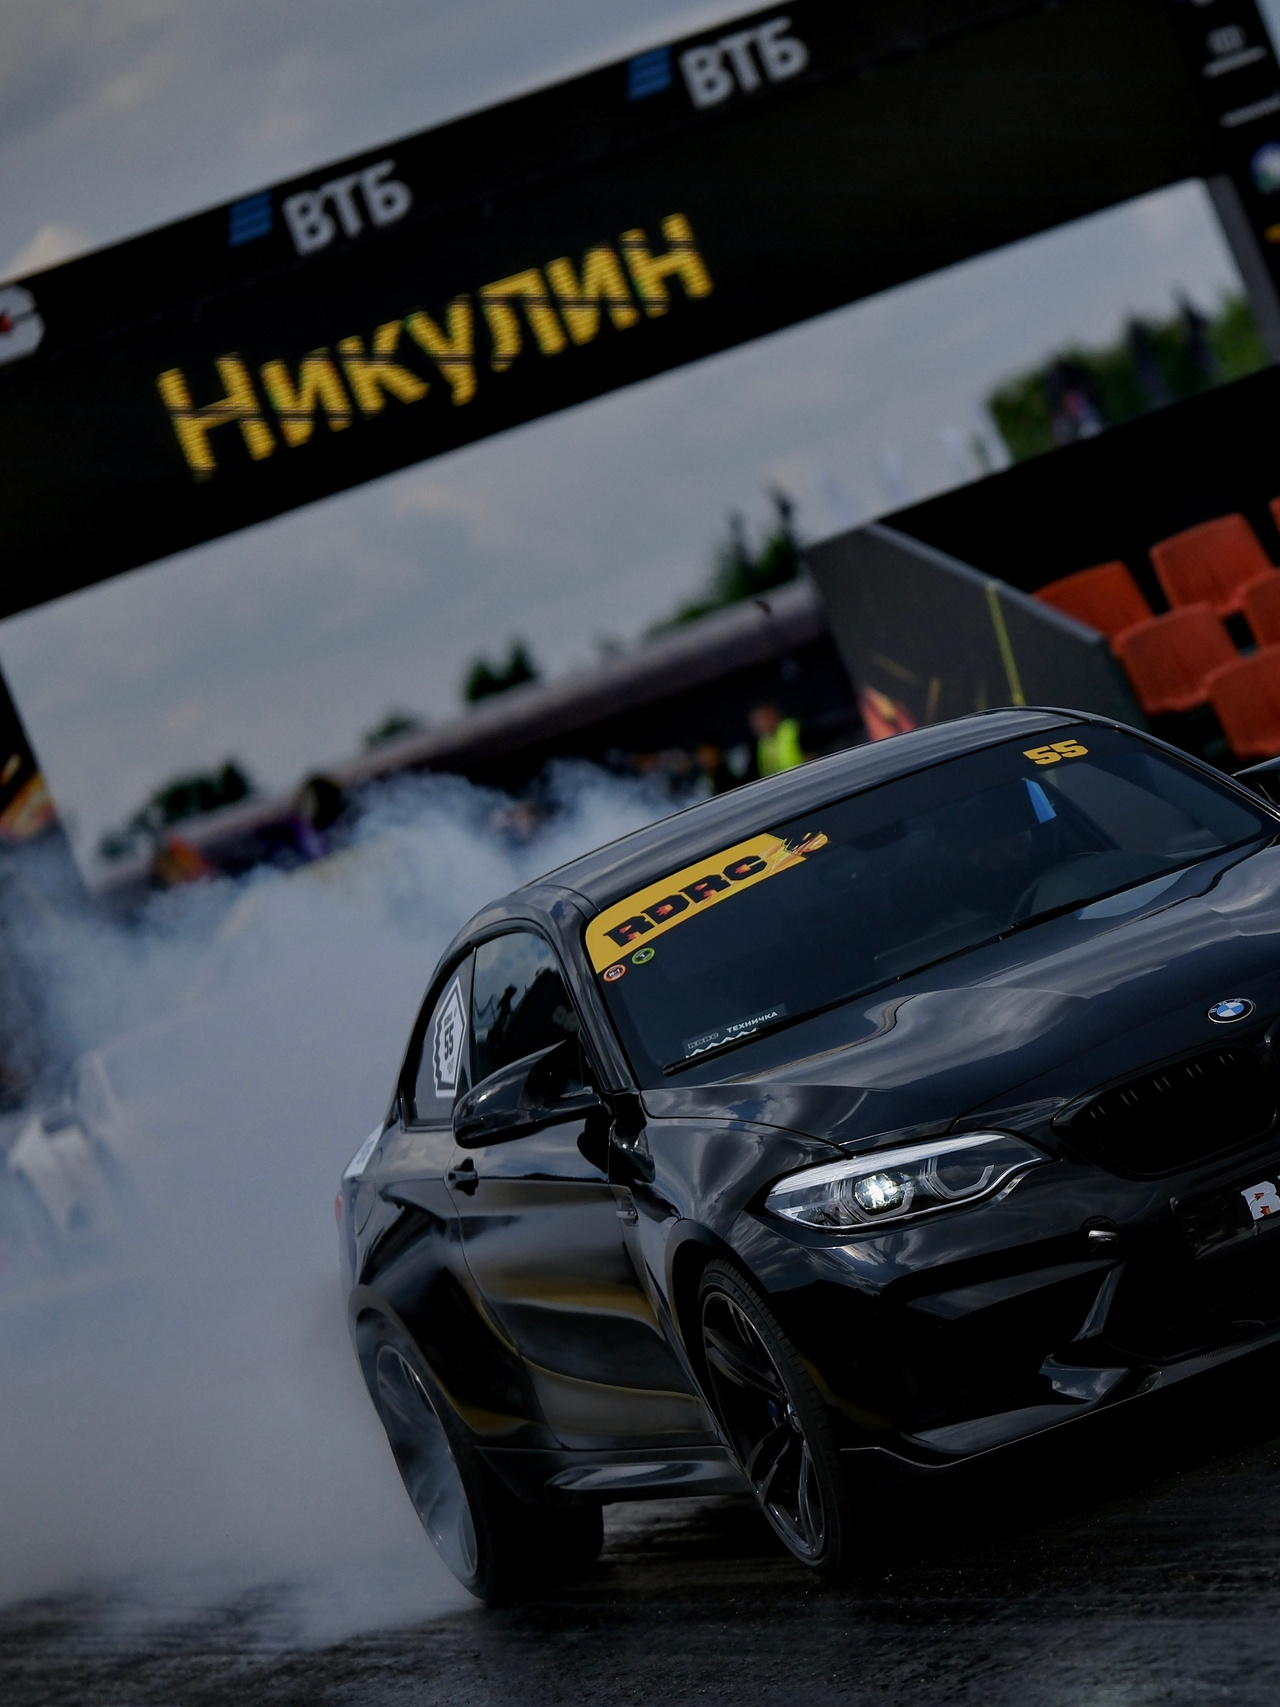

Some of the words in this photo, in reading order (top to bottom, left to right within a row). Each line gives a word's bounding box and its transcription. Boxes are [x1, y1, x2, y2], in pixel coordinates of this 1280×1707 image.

[679, 17, 811, 111] ВТБ
[283, 160, 415, 257] ВТБ
[156, 213, 715, 485] Никулин
[1022, 738, 1089, 766] 55
[603, 855, 767, 947] RDRC
[726, 1011, 778, 1033] ТЕХНИЧКА
